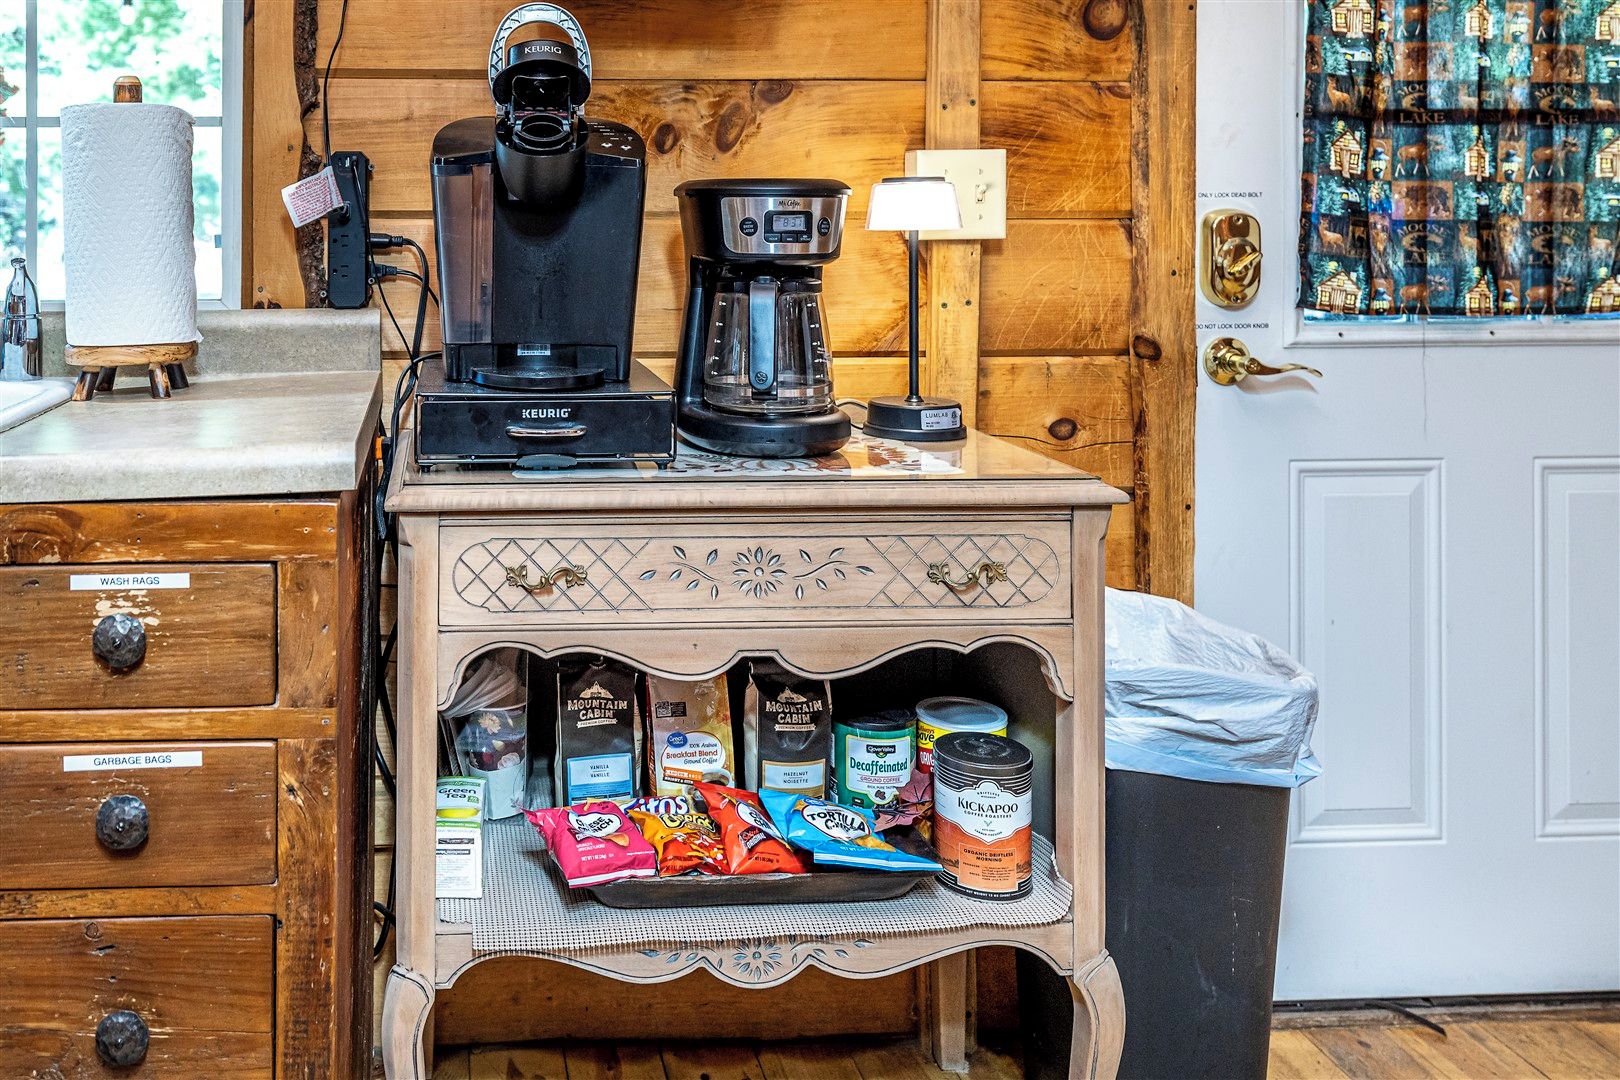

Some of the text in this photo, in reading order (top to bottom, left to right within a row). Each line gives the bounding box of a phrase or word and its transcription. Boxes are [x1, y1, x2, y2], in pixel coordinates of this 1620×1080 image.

[524, 45, 562, 54] KEURIG
[1400, 112, 1446, 124] LAKE
[522, 408, 571, 419] KEURIG
[100, 576, 160, 586] WASH RAGS
[567, 700, 628, 711] MOUNTAIN
[765, 700, 823, 713] MOUNTAIN
[579, 709, 614, 720] CABIN
[777, 713, 811, 724] CABIN
[666, 749, 718, 759] Breakfast Blend
[93, 755, 172, 766] GARBAGE BAGS
[850, 757, 908, 775] Decaffeinated
[957, 796, 1019, 814] KICKAPOO
[964, 810, 984, 818] COFFEE
[807, 811, 866, 832] TORTILLA
[963, 848, 988, 857] ORGANIC
